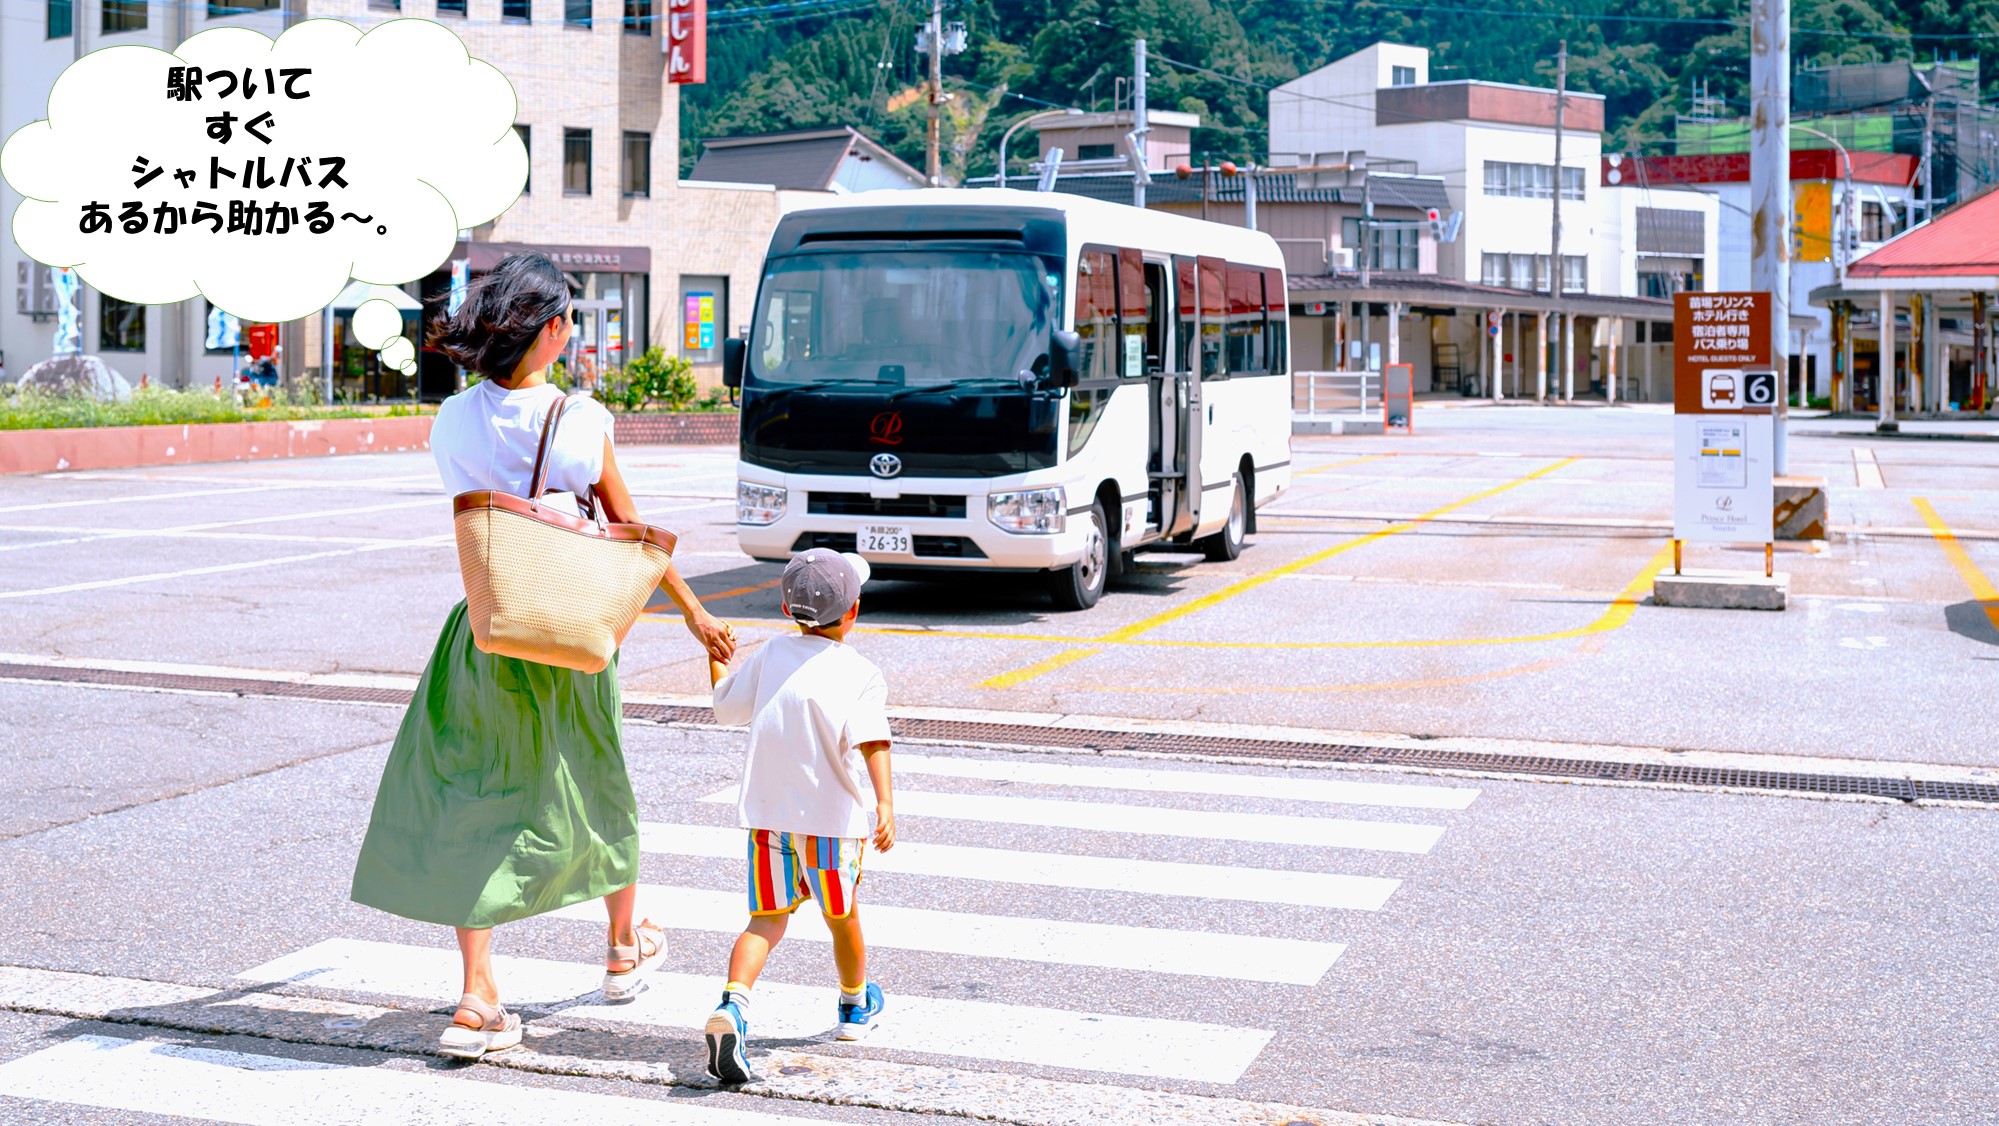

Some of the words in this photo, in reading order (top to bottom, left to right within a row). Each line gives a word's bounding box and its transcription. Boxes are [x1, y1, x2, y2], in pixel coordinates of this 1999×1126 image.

[669, 0, 691, 75] しん
[1688, 295, 1755, 310] 苗場プリンス
[1693, 309, 1749, 322] ホテル行き
[1691, 324, 1750, 338] 宿泊者専用
[1693, 338, 1749, 351] バス乗り場
[1687, 354, 1709, 363] HOTEL
[1710, 354, 1737, 363] GUESTS
[1738, 354, 1757, 363] ONLY
[1749, 375, 1770, 403] 6
[868, 535, 908, 551] 26-39
